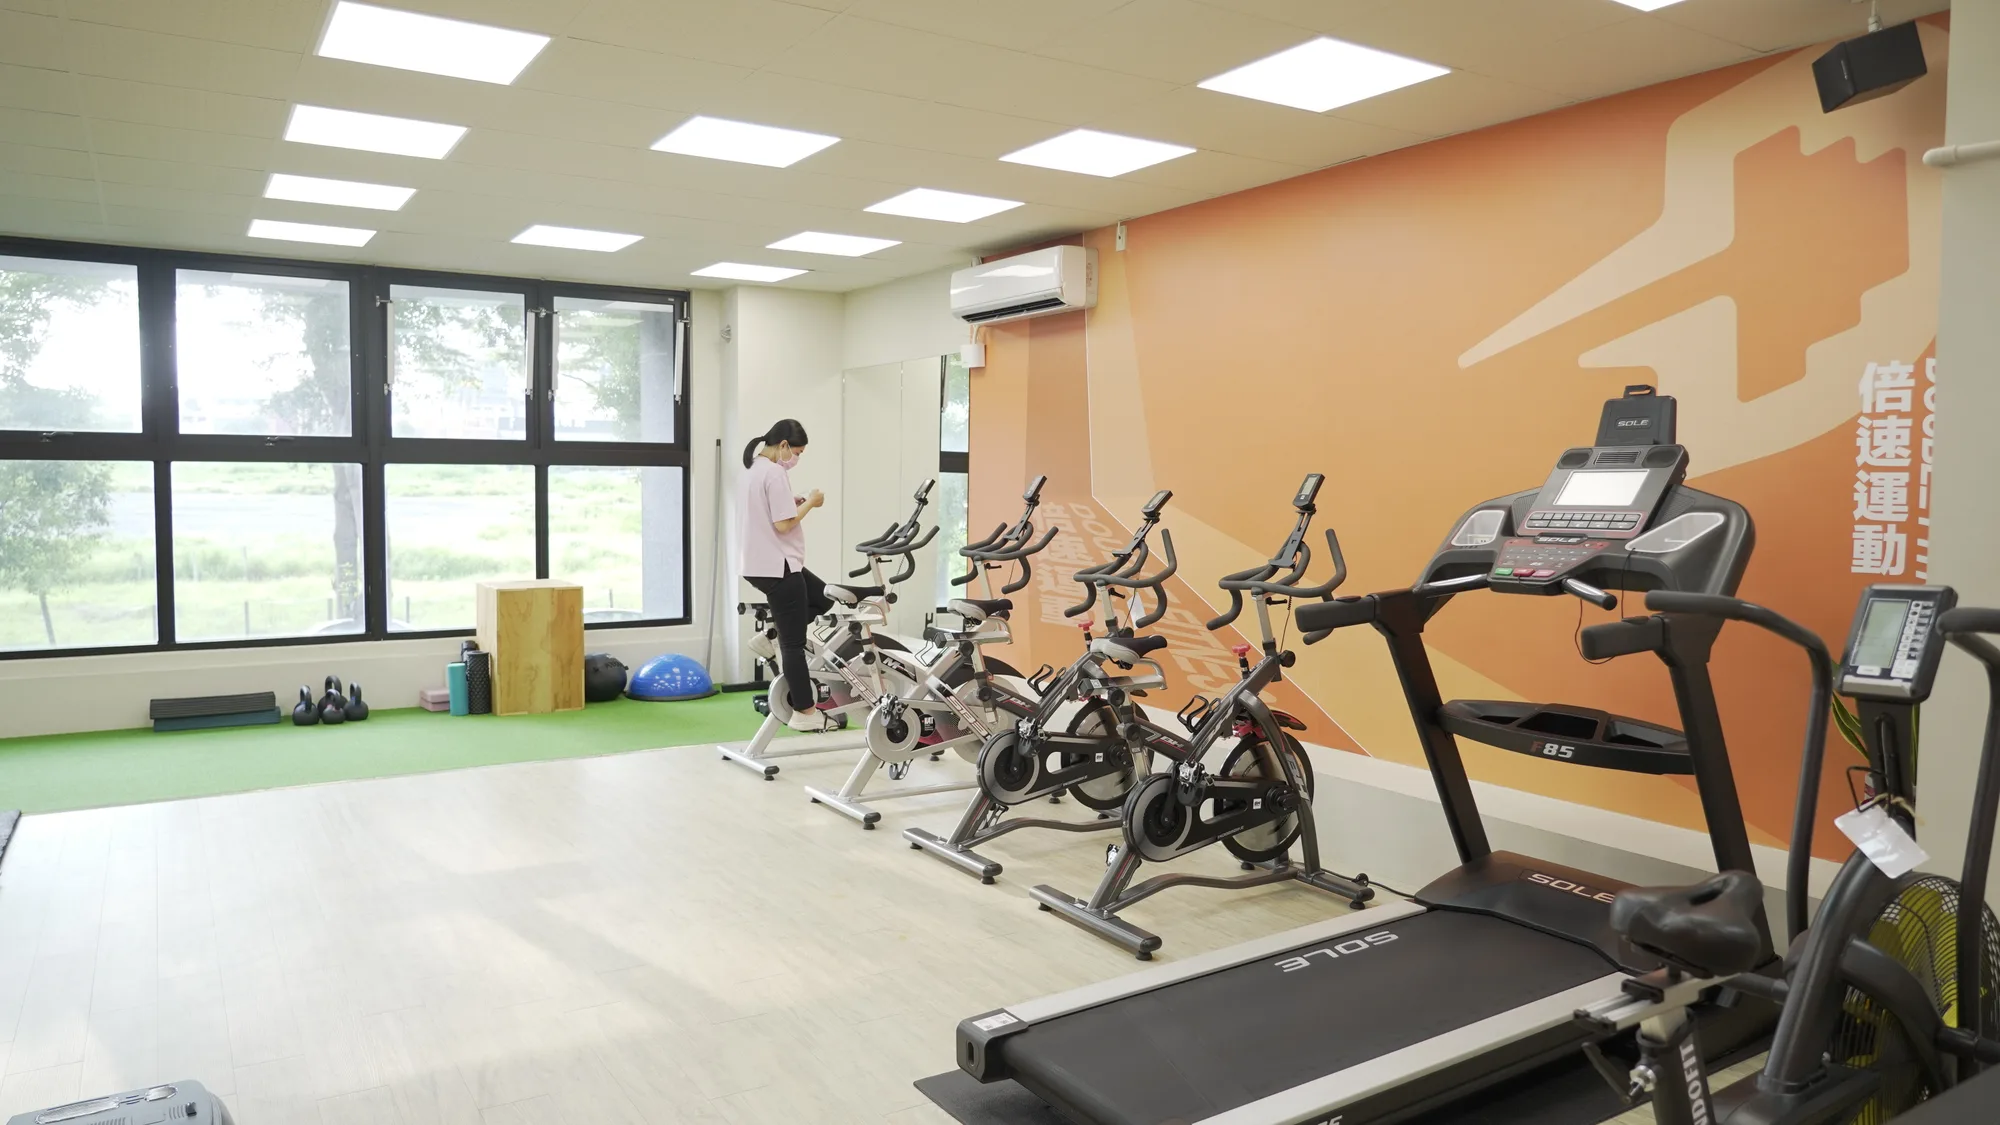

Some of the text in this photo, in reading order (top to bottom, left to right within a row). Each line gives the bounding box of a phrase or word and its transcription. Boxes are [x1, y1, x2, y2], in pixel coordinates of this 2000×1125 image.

[1617, 419, 1649, 427] SOLE
[1851, 360, 1915, 576] 倍速運動
[1527, 873, 1616, 904] SOLE
[1274, 931, 1399, 972] SOLE
